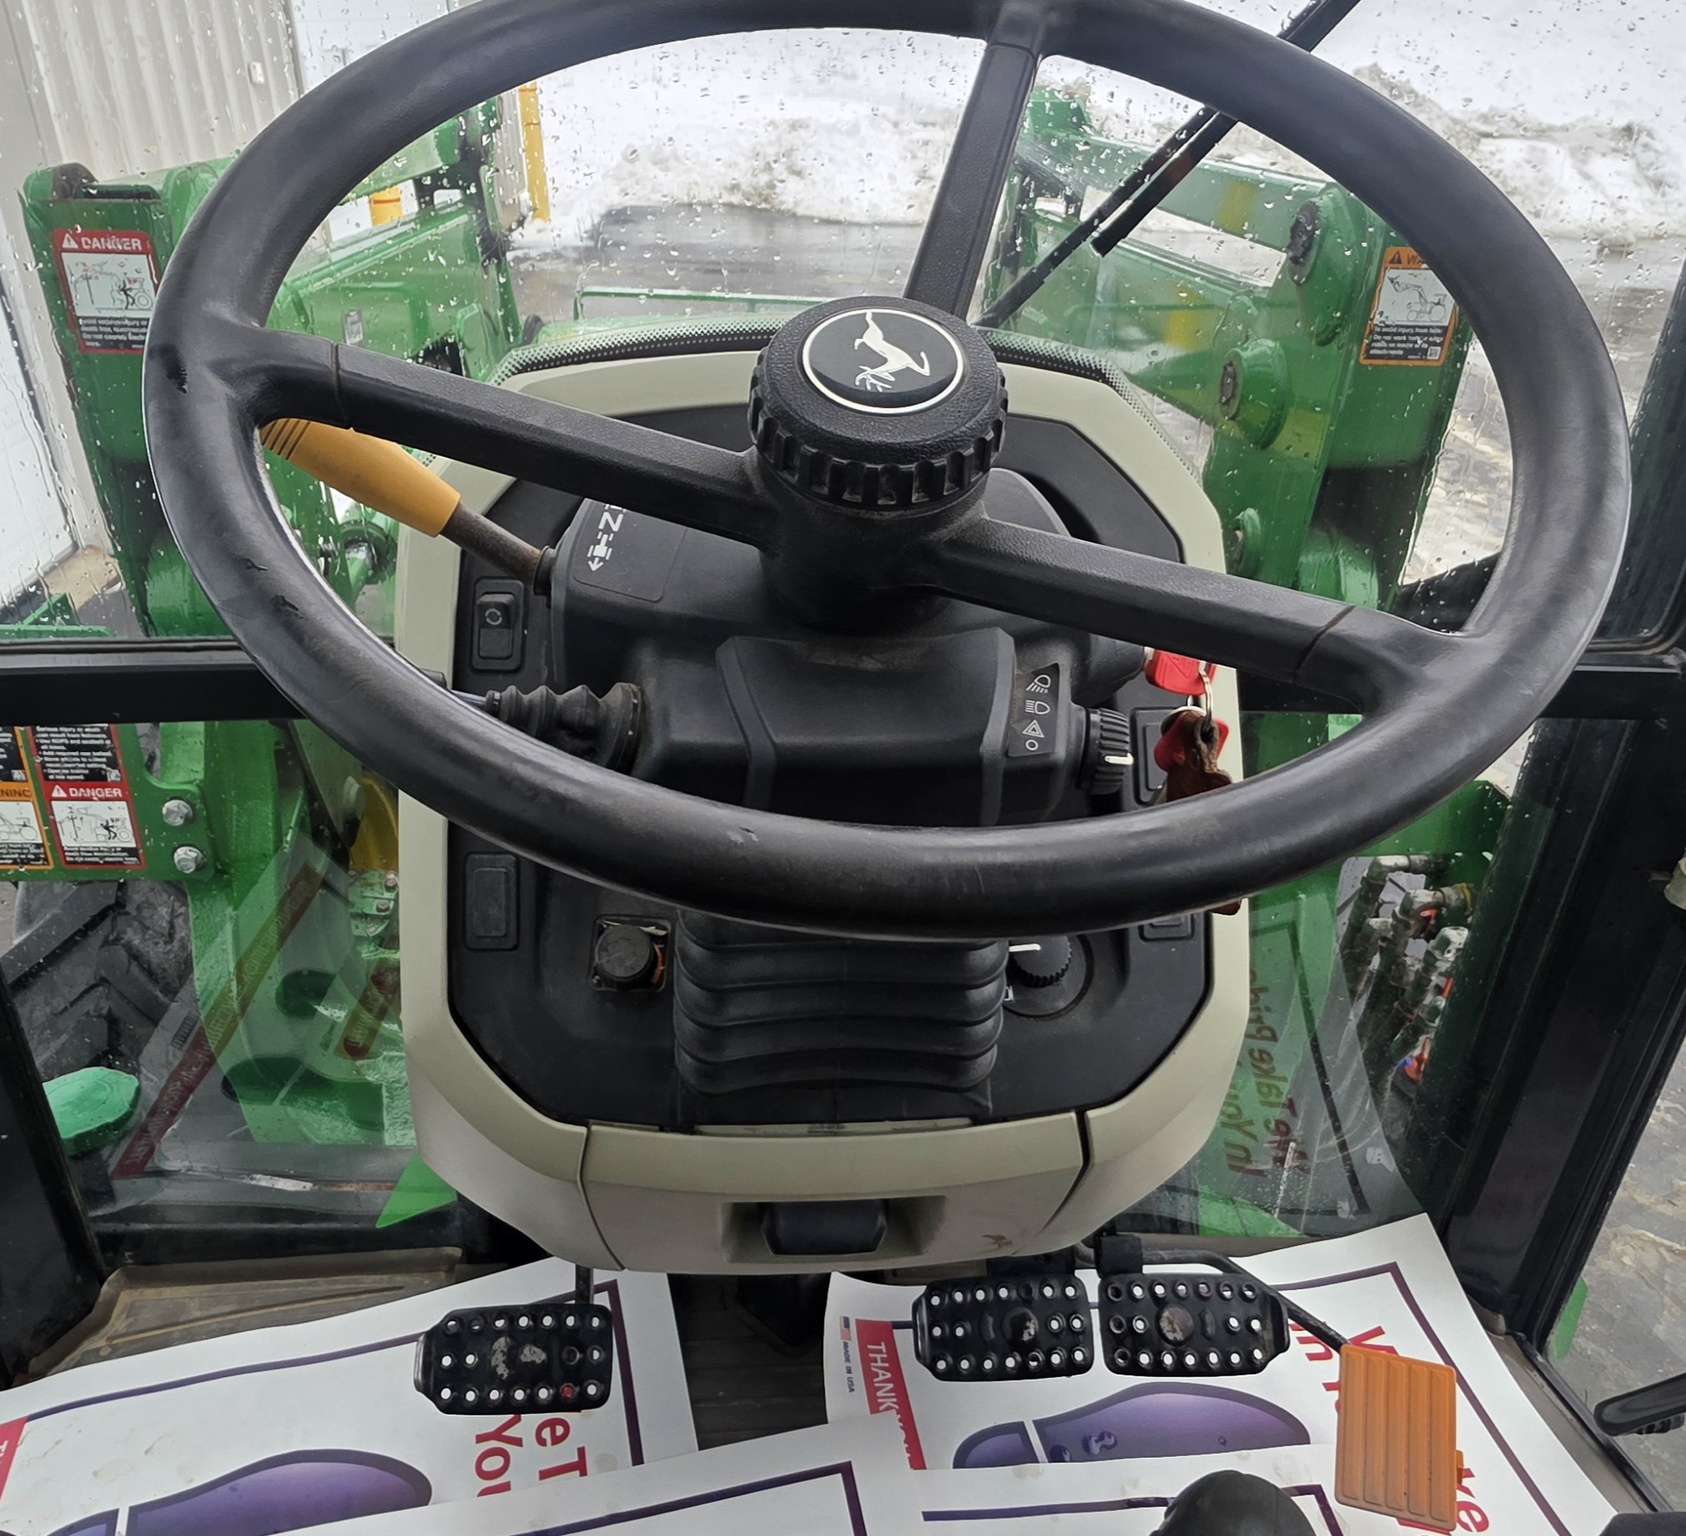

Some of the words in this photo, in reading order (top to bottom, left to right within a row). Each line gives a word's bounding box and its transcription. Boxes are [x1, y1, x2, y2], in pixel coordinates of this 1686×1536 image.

[69, 787, 123, 798] DANGER
[843, 1340, 852, 1364] MADE
[845, 1366, 853, 1375] IN
[866, 1341, 899, 1410] THANK
[846, 1377, 855, 1393] USA
